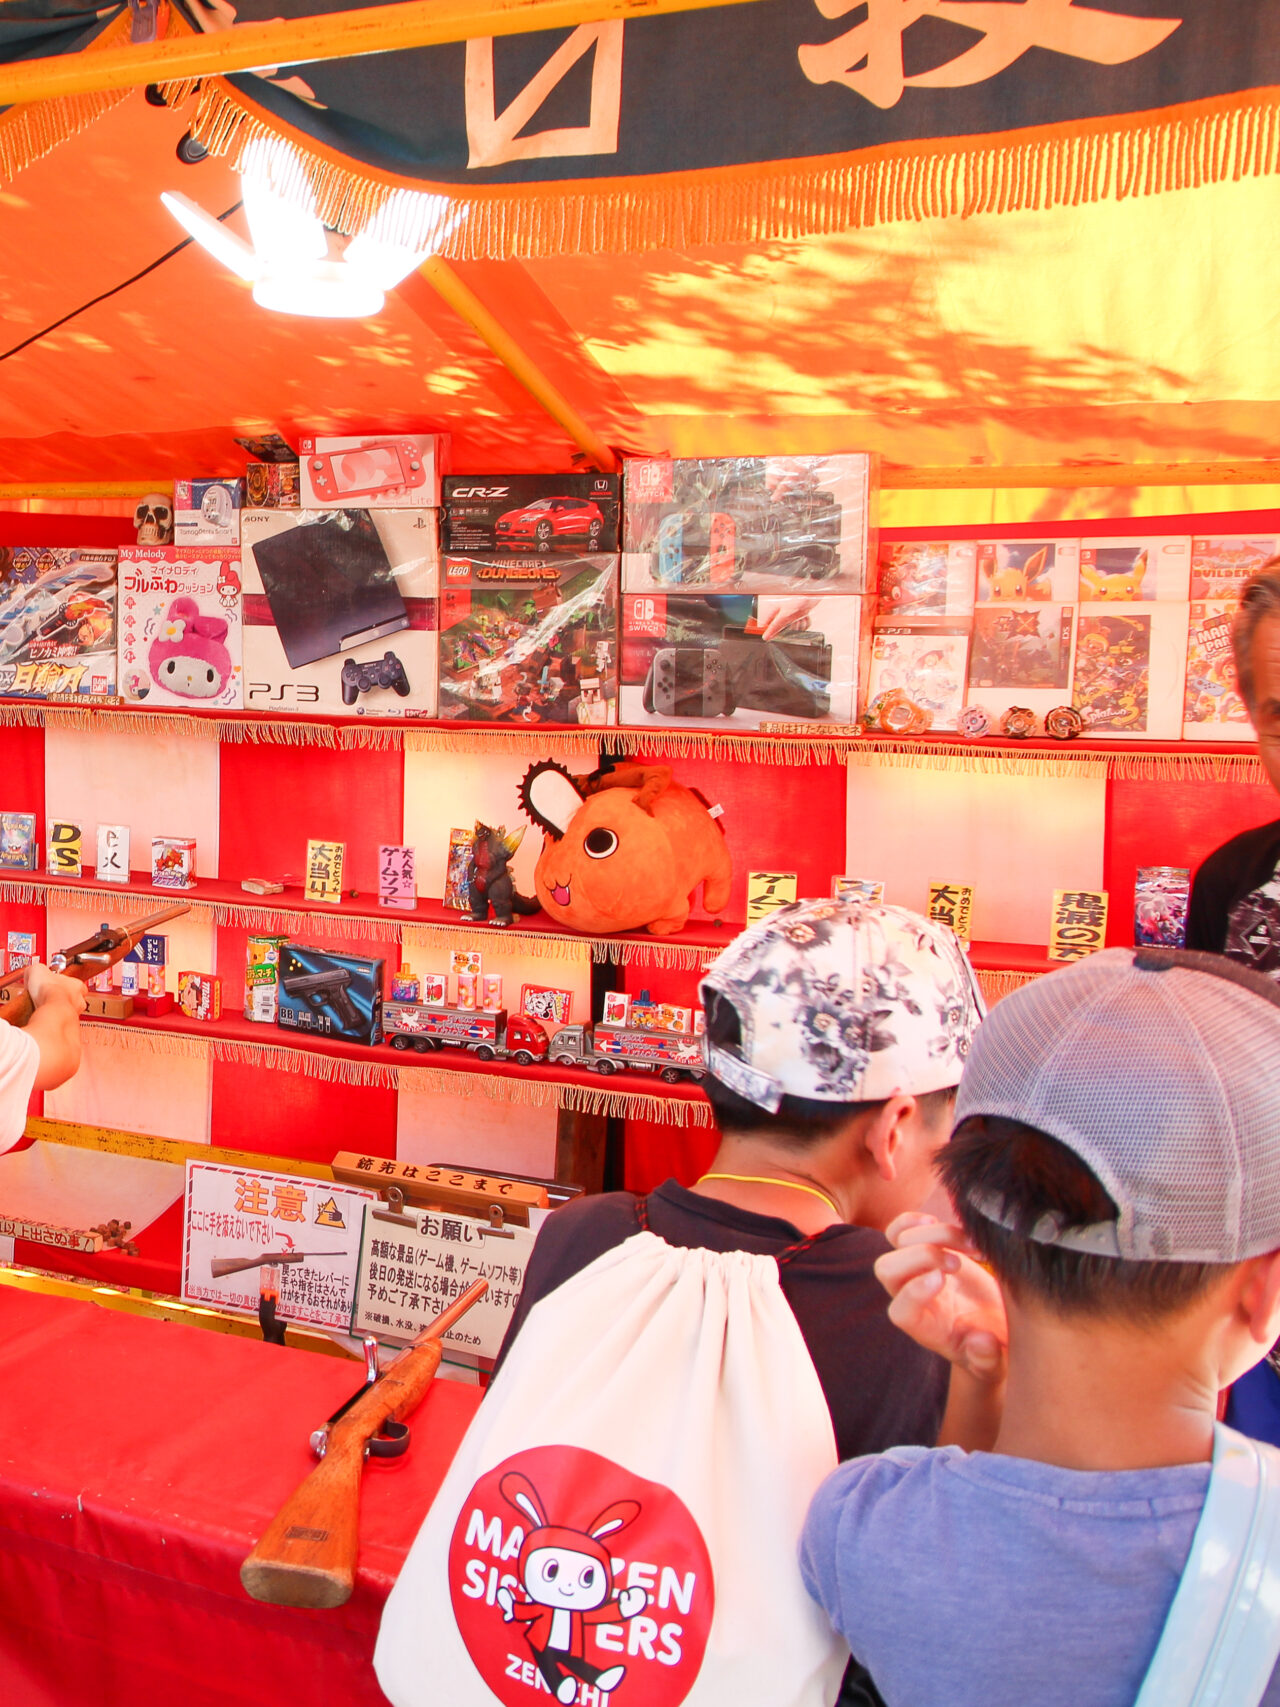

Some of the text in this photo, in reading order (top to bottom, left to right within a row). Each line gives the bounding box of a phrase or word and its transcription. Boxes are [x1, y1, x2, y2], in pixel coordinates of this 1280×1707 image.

[410, 496, 433, 506] Lite
[452, 486, 510, 498] CR-Z
[120, 549, 134, 559] My
[135, 549, 167, 559] Melody
[490, 559, 548, 568] MINECRAFT
[150, 566, 198, 575] マイメロディ
[448, 565, 469, 576] LEGO
[480, 568, 557, 581] DUNGEONS
[1196, 622, 1232, 644] MAR
[1205, 637, 1232, 653] PAR
[7, 661, 89, 694] 日輪刀
[249, 683, 319, 702] PS3
[1079, 703, 1128, 724] Splatoon
[310, 844, 333, 897] 大当り
[381, 847, 399, 905] ゲームソフト
[197, 981, 211, 1021] Milky
[281, 1008, 294, 1019] BB
[355, 1156, 514, 1195] 銃先はここまで
[234, 1177, 308, 1223] 注意
[191, 1210, 275, 1246] ここに手を添えないで下さい
[419, 1214, 484, 1243] お願い
[281, 1263, 350, 1287] 戻ってきたレバーに
[280, 1276, 347, 1299] 手や指をはさんで
